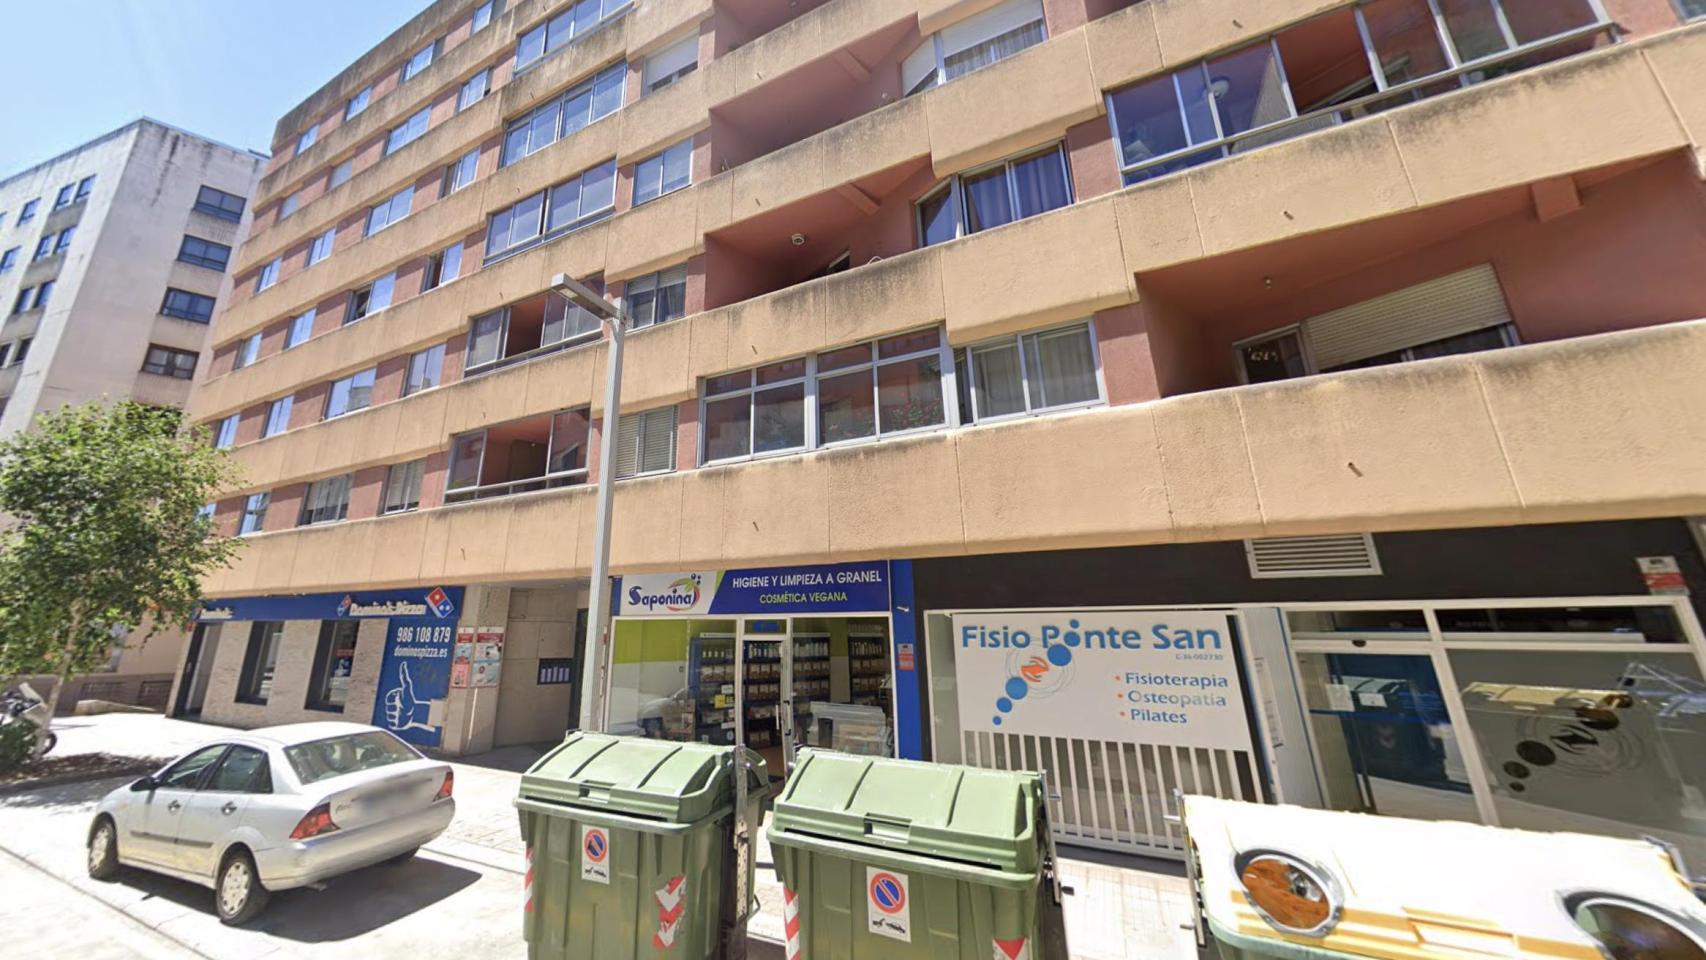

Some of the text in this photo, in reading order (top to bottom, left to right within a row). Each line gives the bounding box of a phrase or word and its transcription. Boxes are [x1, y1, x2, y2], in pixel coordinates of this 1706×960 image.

[732, 570, 882, 588] HIGIENE Y LIMPIEZA A GRANEL
[628, 585, 693, 611] Saponina
[759, 591, 848, 604] COSMÉTICA VEGANA
[396, 626, 413, 643] 986
[415, 626, 431, 643] 108
[433, 626, 451, 643] 879
[961, 624, 1222, 649] Fisio Ponte San
[394, 645, 448, 659] dominospizza.es
[1125, 672, 1229, 690] Fisioterapia
[1127, 690, 1227, 707] Osteopatia
[1130, 708, 1188, 724] Pilates
